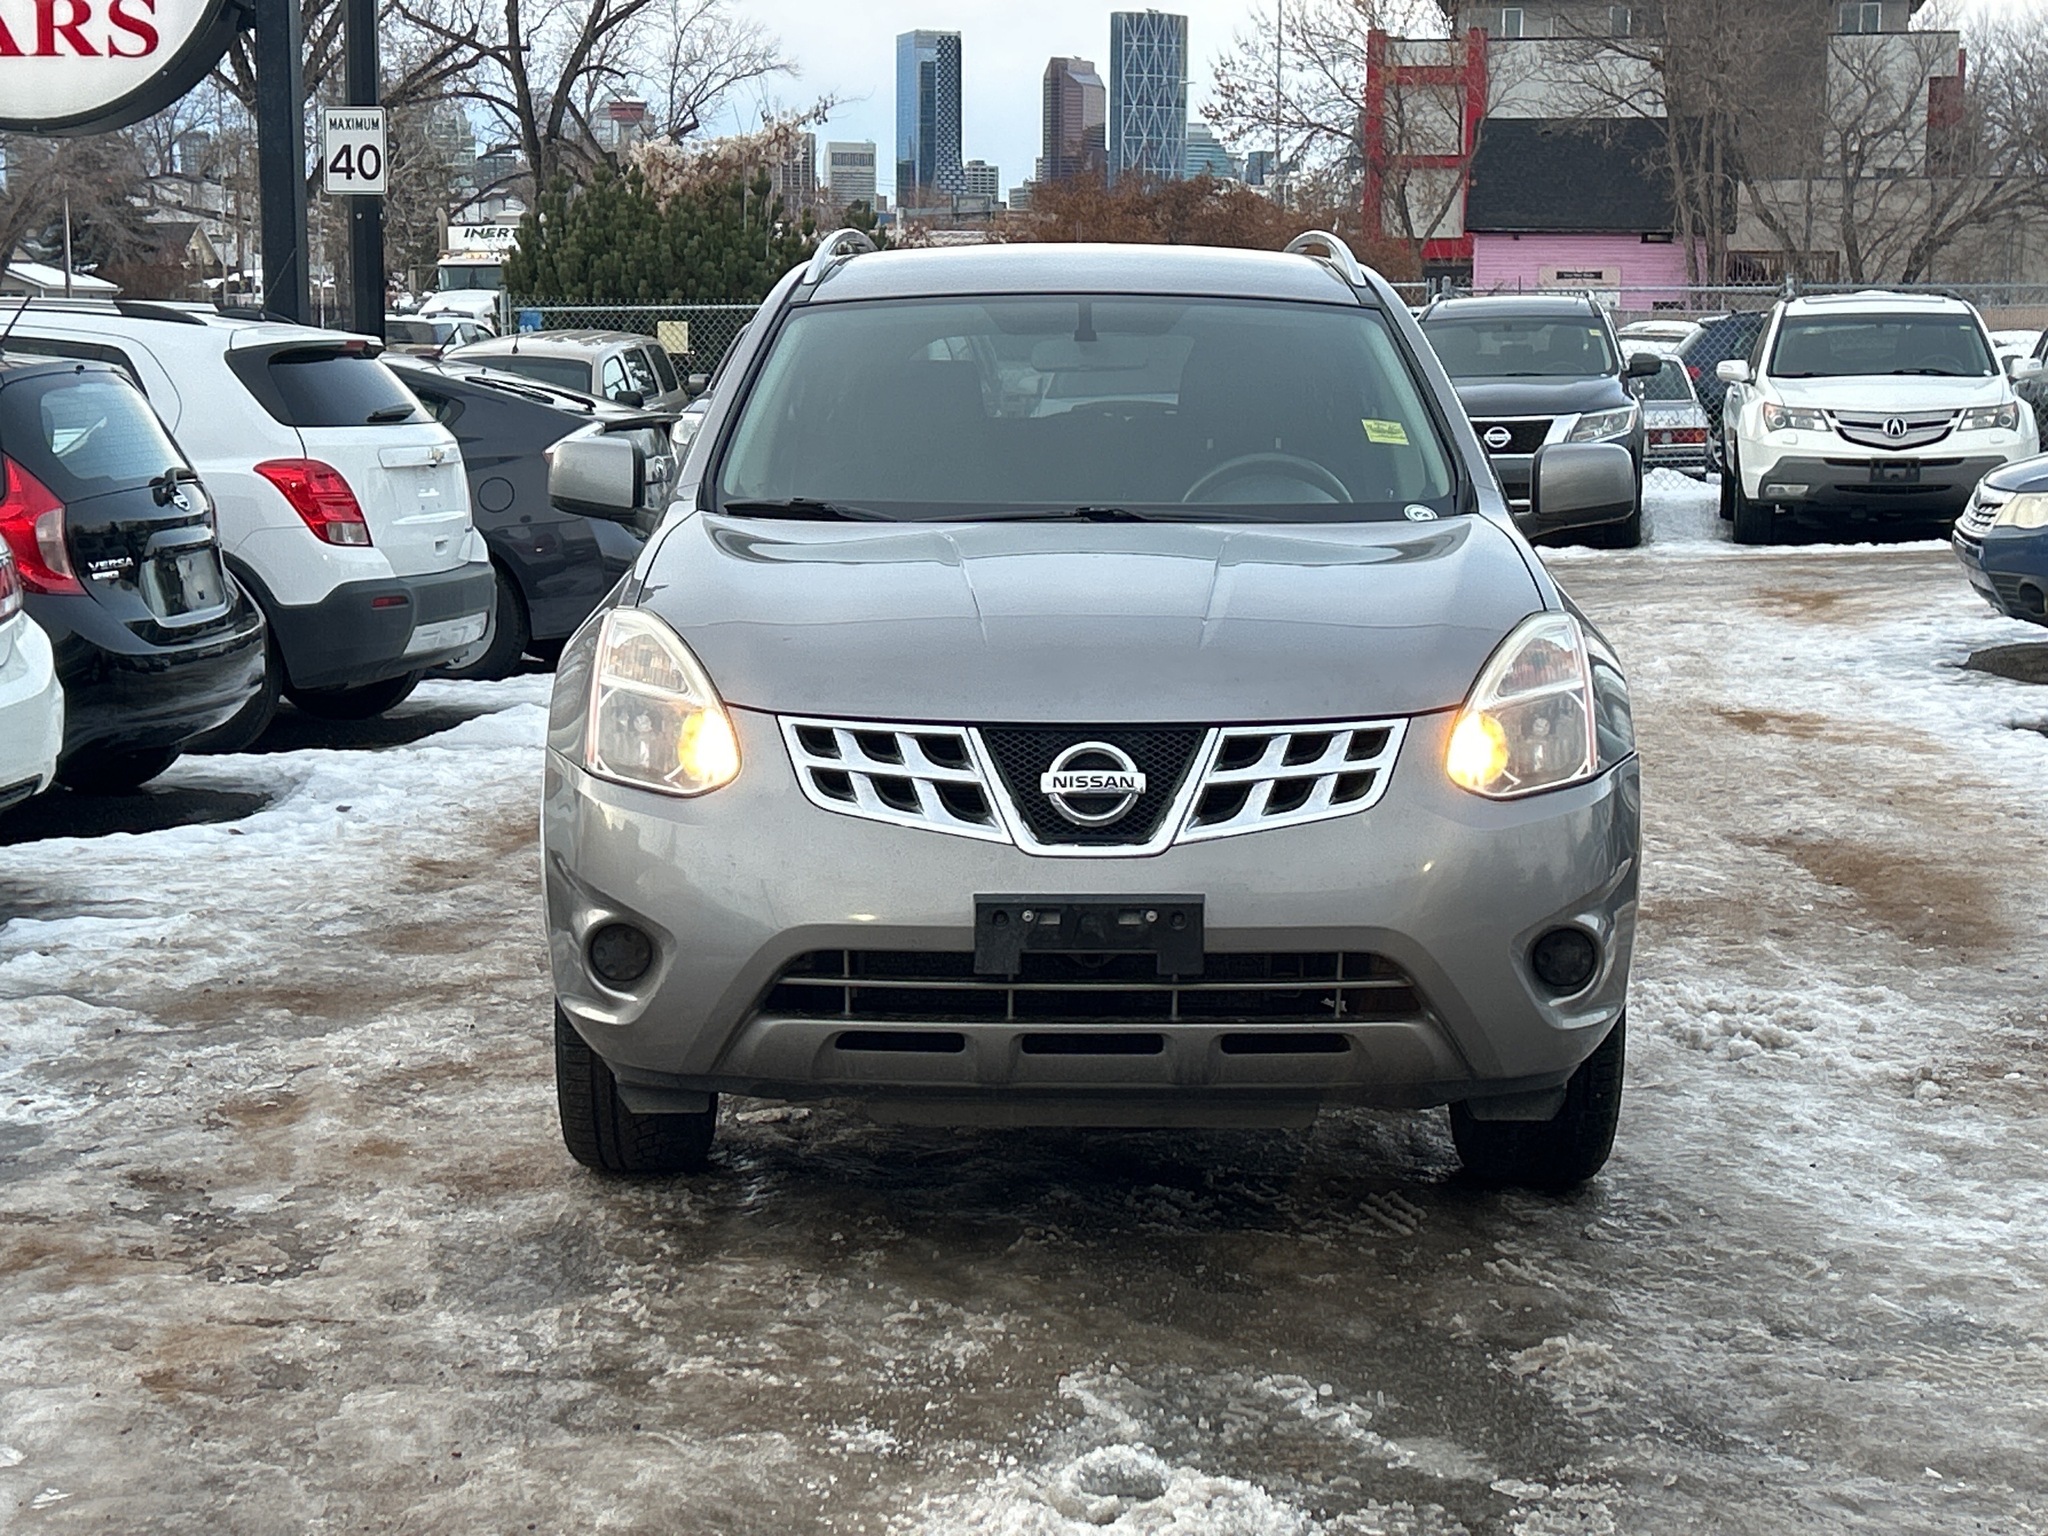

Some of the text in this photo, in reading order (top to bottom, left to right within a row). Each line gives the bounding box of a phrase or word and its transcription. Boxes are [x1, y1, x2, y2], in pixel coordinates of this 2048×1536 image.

[329, 117, 380, 131] MAXIMUM
[329, 144, 381, 180] 40
[1053, 776, 1135, 788] NISSAN
